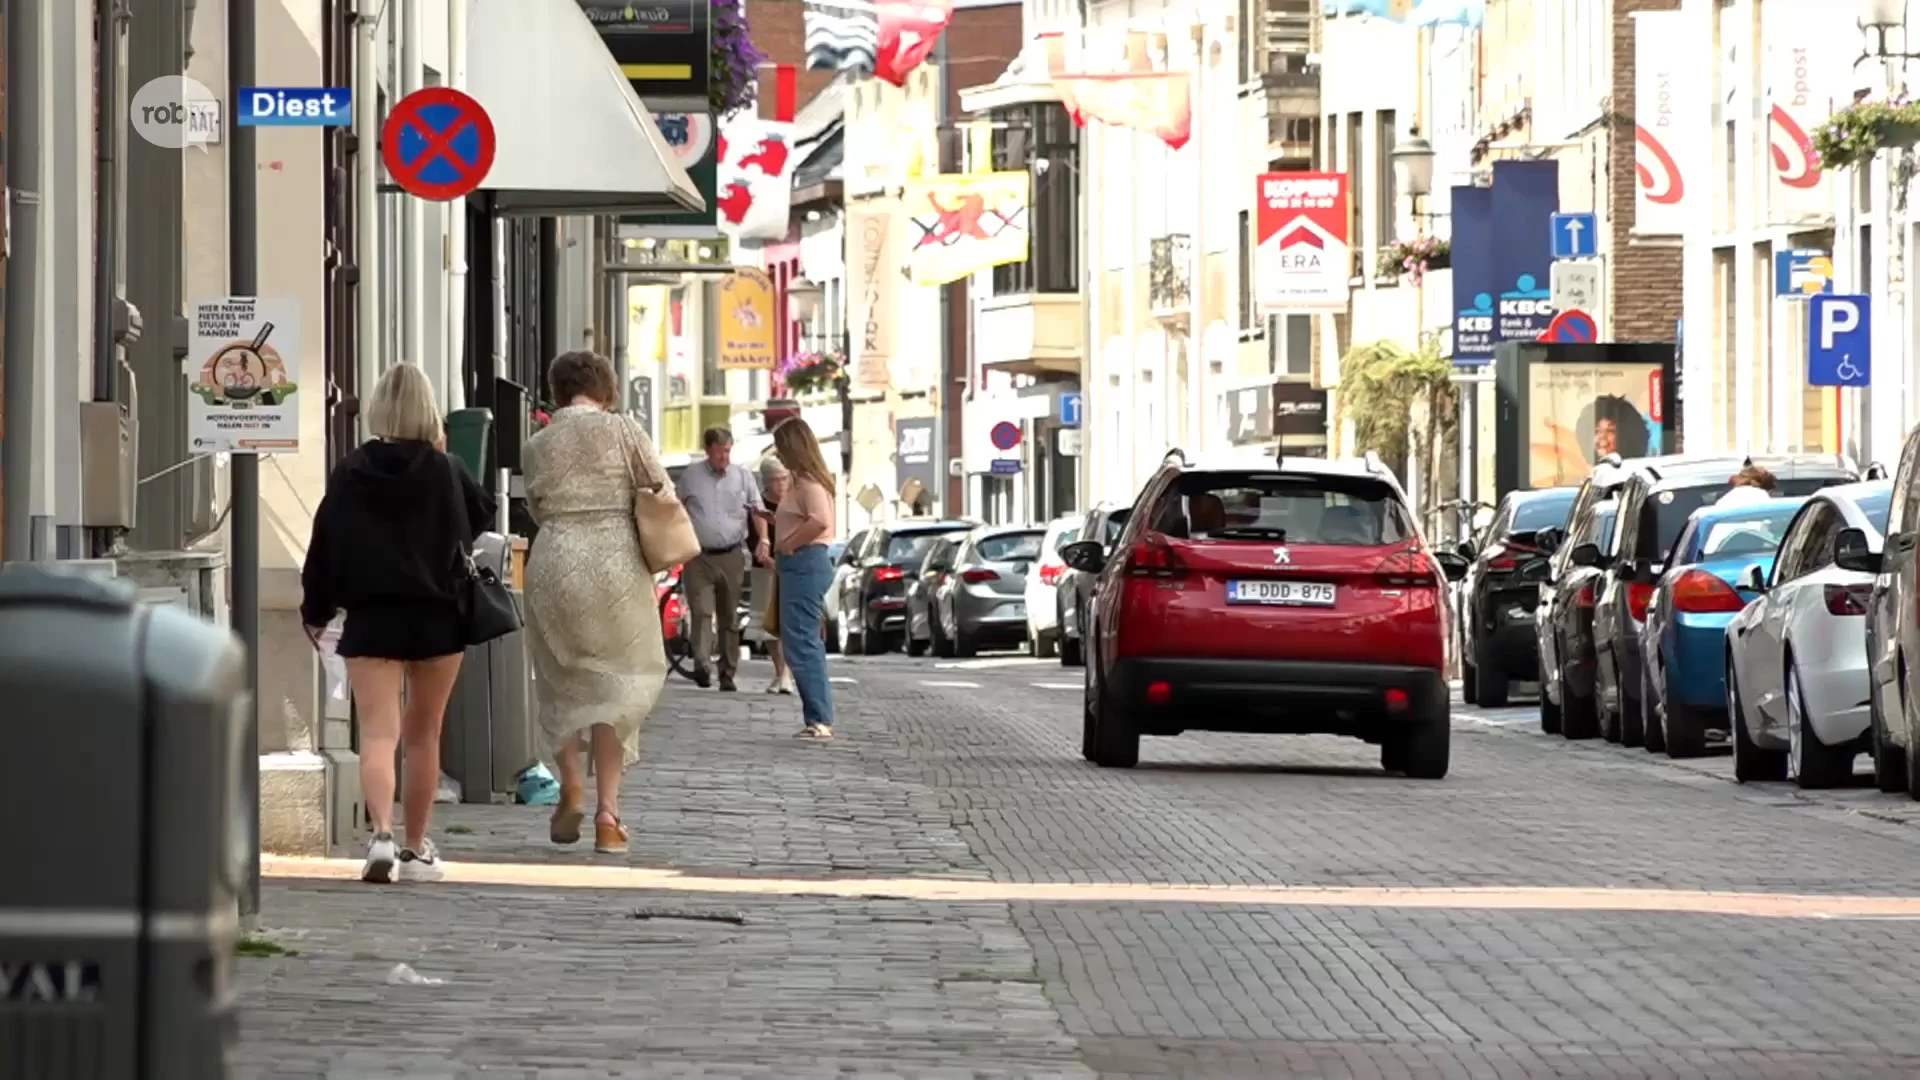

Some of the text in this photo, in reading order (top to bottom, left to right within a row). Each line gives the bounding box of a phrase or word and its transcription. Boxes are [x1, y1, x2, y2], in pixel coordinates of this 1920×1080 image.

[1791, 47, 1811, 107] bpost
[1281, 254, 1321, 268] ERA
[198, 329, 239, 337] HANDEN
[1821, 300, 1860, 349] P
